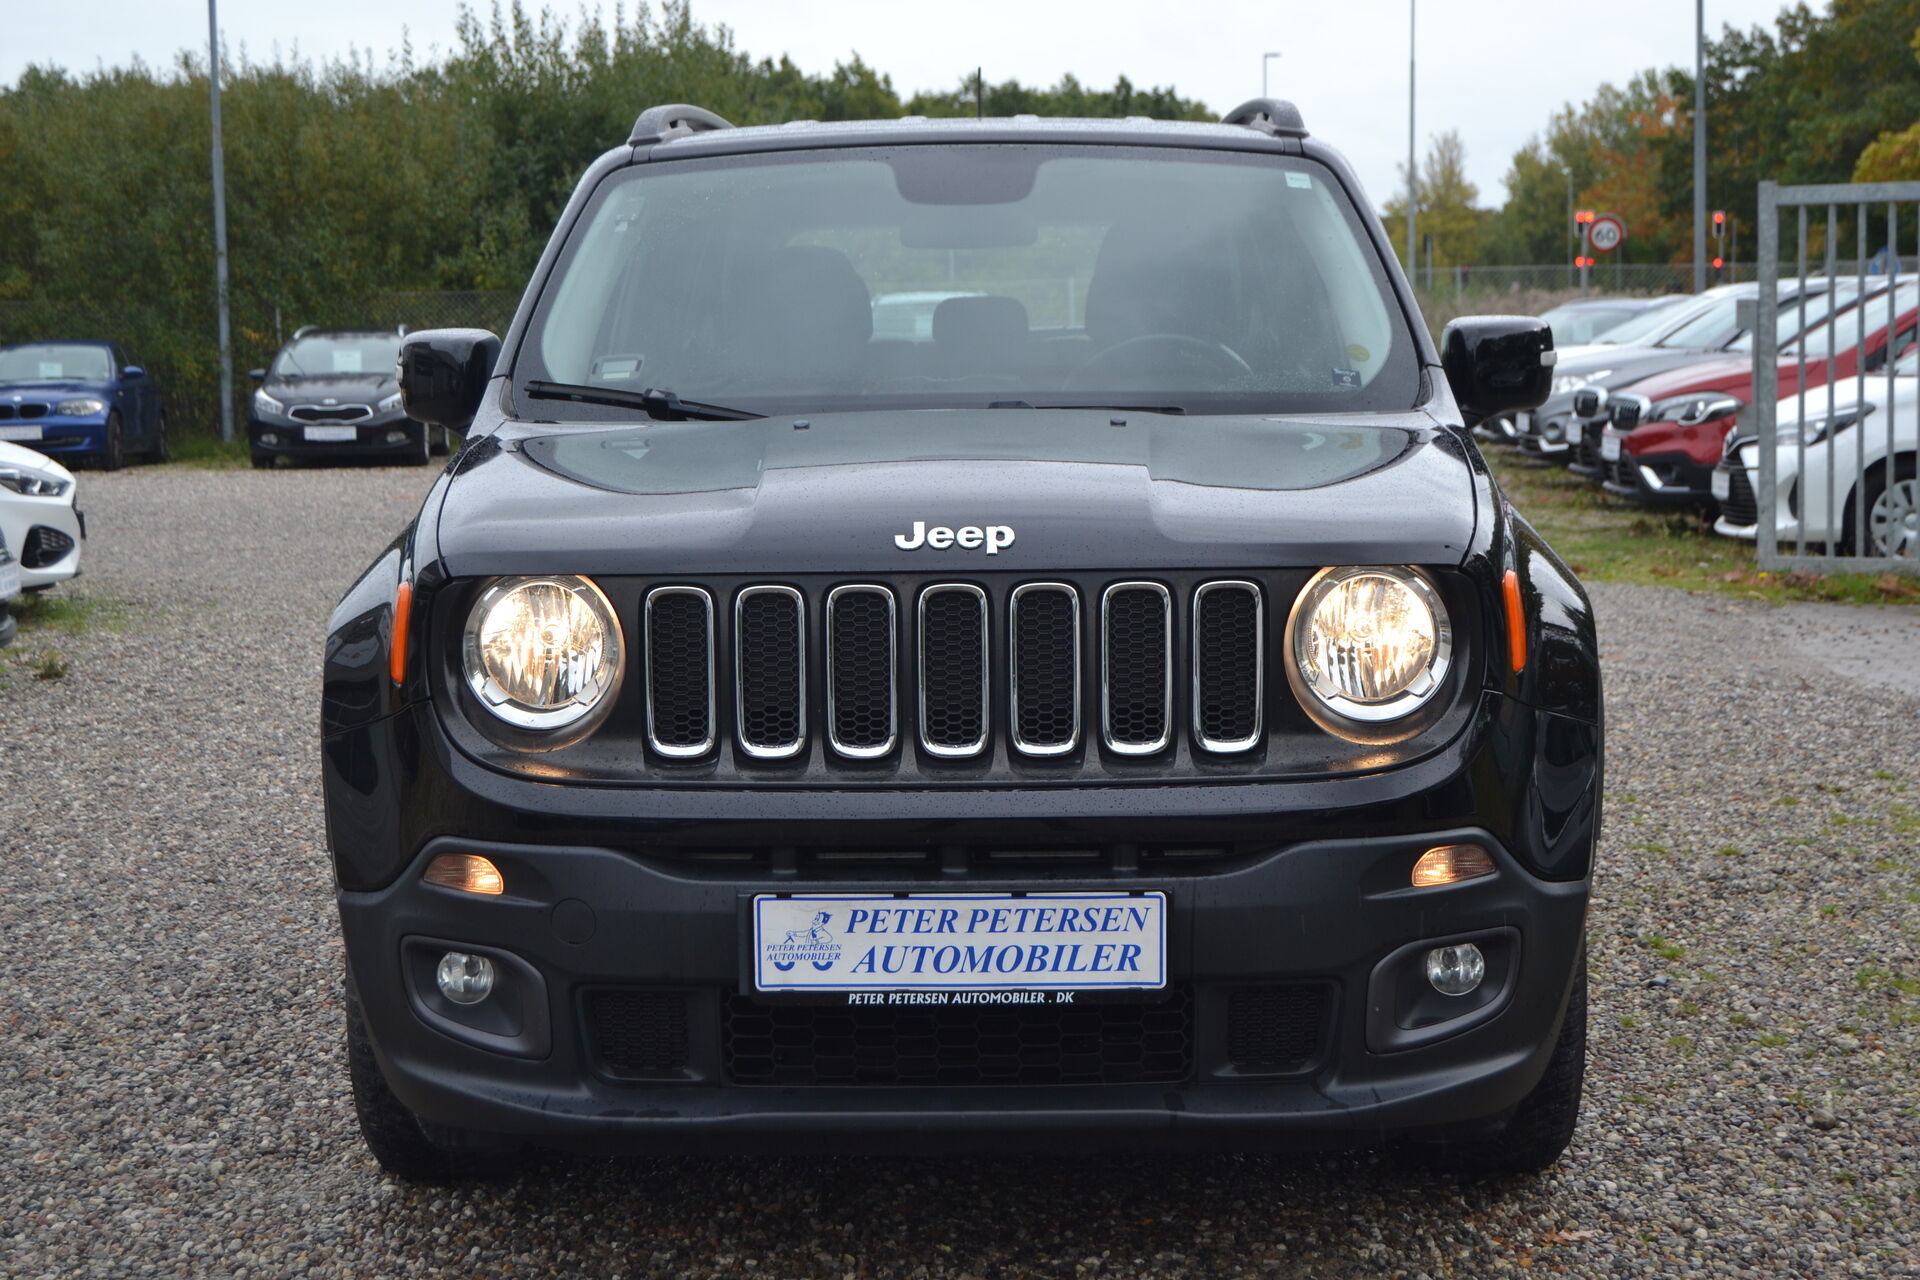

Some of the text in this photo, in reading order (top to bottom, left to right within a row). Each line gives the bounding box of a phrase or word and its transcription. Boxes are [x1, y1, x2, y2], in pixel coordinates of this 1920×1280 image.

[1595, 227, 1617, 242] 60
[894, 521, 1015, 555] Jeep
[844, 907, 1152, 934] PETER PETERSEN
[766, 944, 795, 952] PETER
[766, 952, 842, 961] AUTOMOBILER
[850, 944, 1142, 974] AUTOMOBILER
[848, 993, 885, 1005] PETER
[888, 992, 949, 1005] PETERSEN
[952, 992, 1045, 1004] AUTOMOBILER
